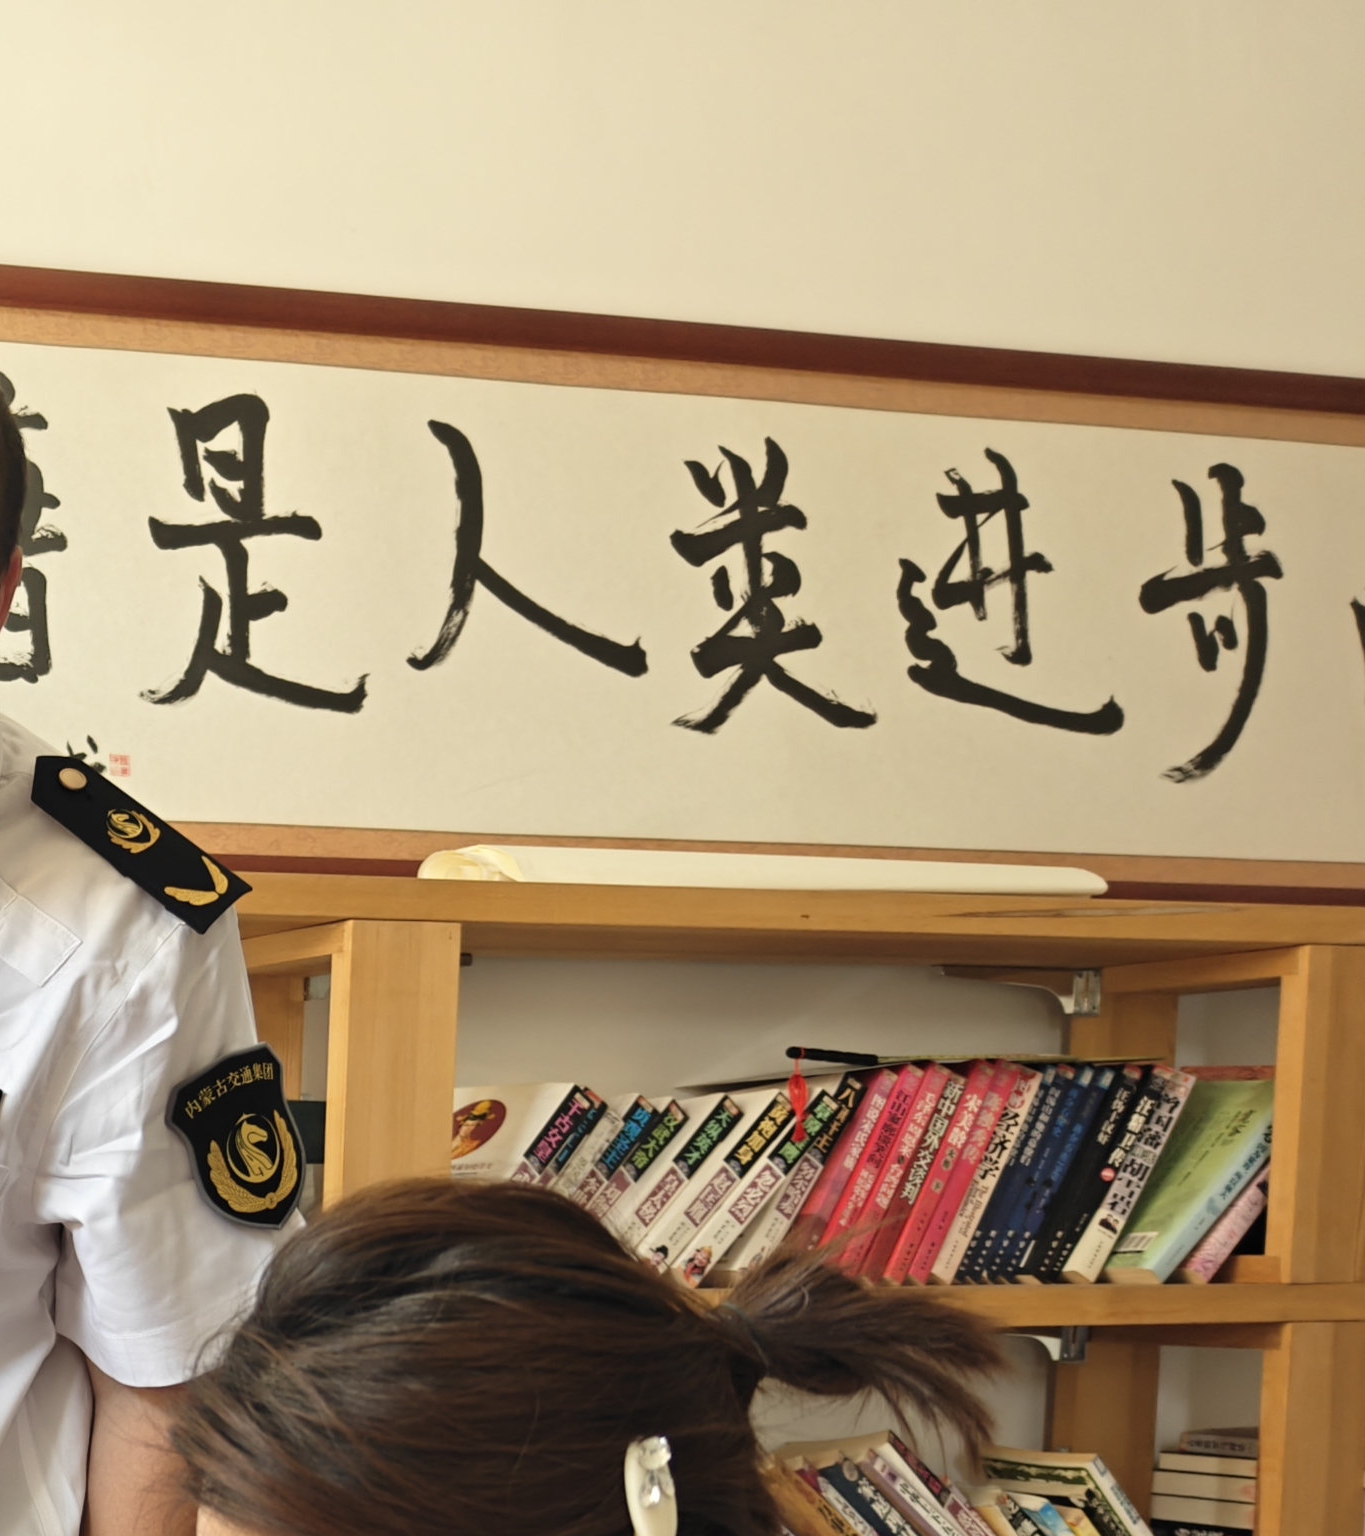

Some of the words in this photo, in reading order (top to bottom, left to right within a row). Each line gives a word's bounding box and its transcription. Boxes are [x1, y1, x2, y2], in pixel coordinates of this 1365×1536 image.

[184, 1062, 275, 1119] 内蒙古交通集团
[534, 1099, 582, 1163] 千古女皇
[736, 1103, 789, 1166] 黄袍加身
[900, 1081, 965, 1205] 新中国外交谈判
[978, 1109, 1021, 1181] 经济学
[687, 1171, 733, 1223] 赵匡胤
[732, 1170, 776, 1222] 忽必烈
